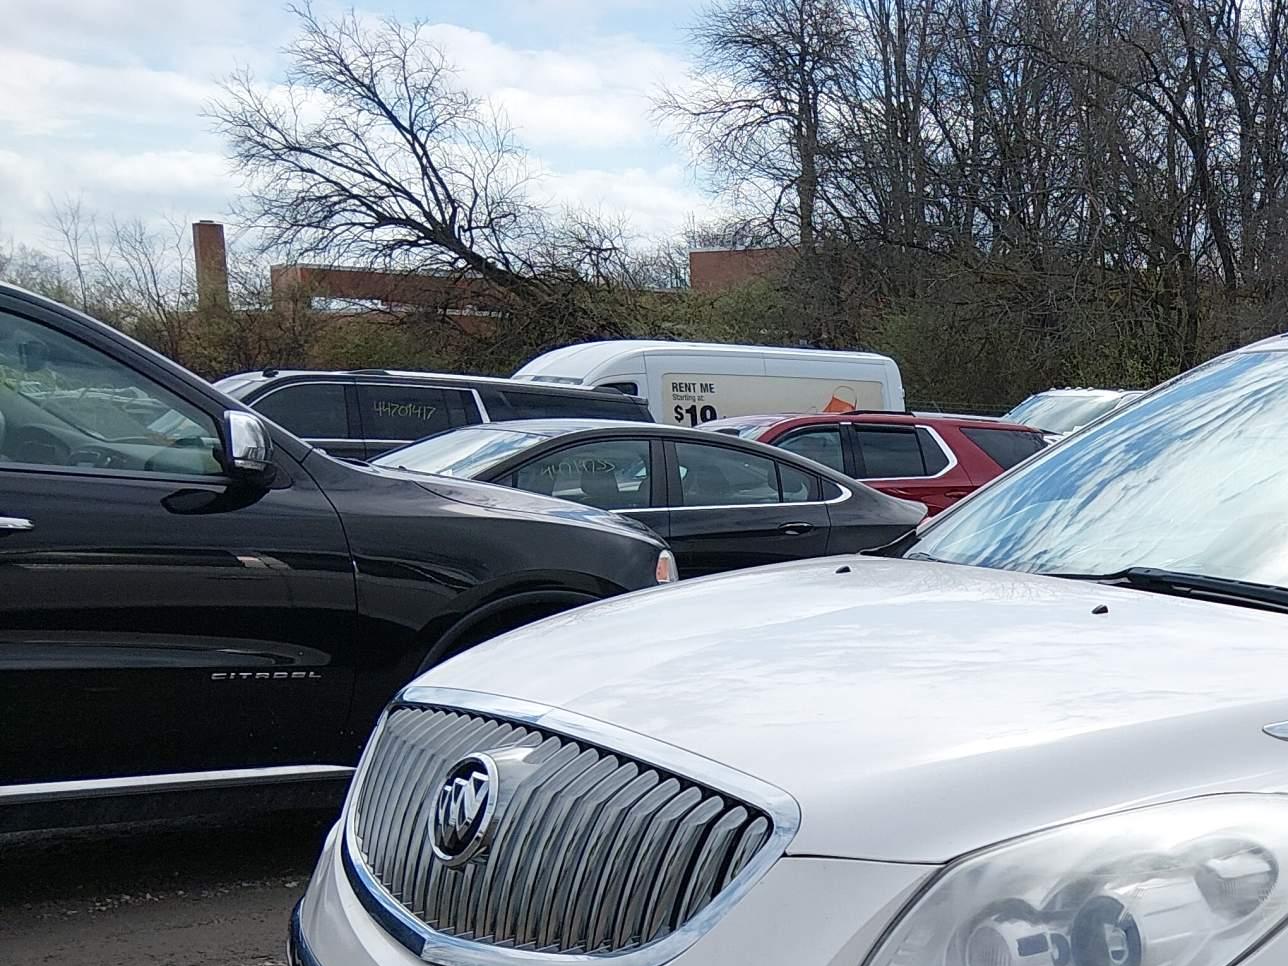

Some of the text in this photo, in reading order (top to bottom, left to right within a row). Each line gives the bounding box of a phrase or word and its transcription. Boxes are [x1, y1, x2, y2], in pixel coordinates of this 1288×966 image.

[671, 382, 716, 394] RENT ME
[672, 393, 696, 403] Starting
[211, 672, 321, 680] CITADEL
